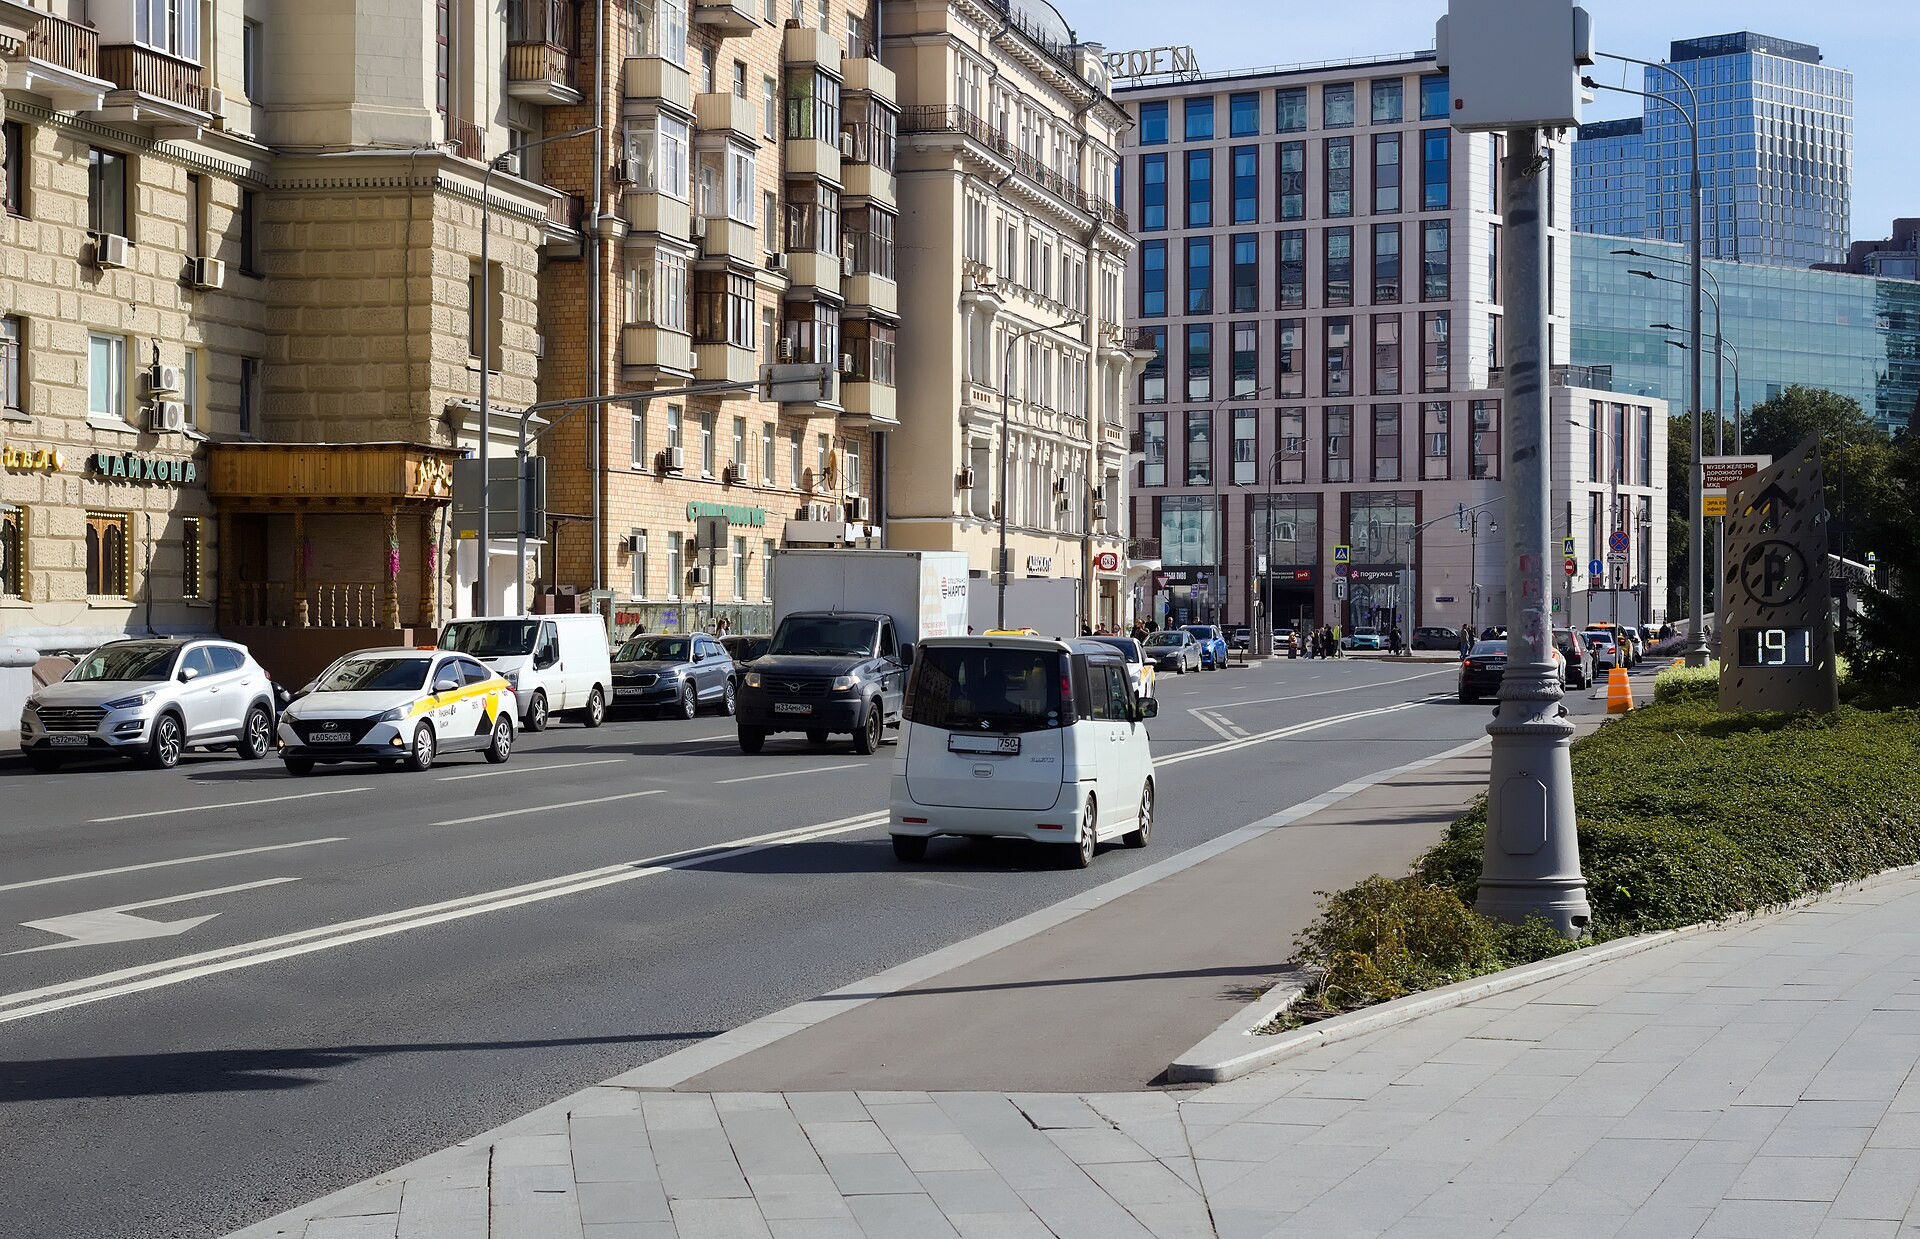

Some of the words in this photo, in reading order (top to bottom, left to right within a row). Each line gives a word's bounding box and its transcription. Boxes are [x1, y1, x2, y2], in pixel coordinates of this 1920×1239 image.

[97, 452, 196, 482] ЧАЙХОНА
[1360, 571, 1393, 580] подружка
[1758, 630, 1809, 664] 191
[999, 738, 1016, 748] 750
